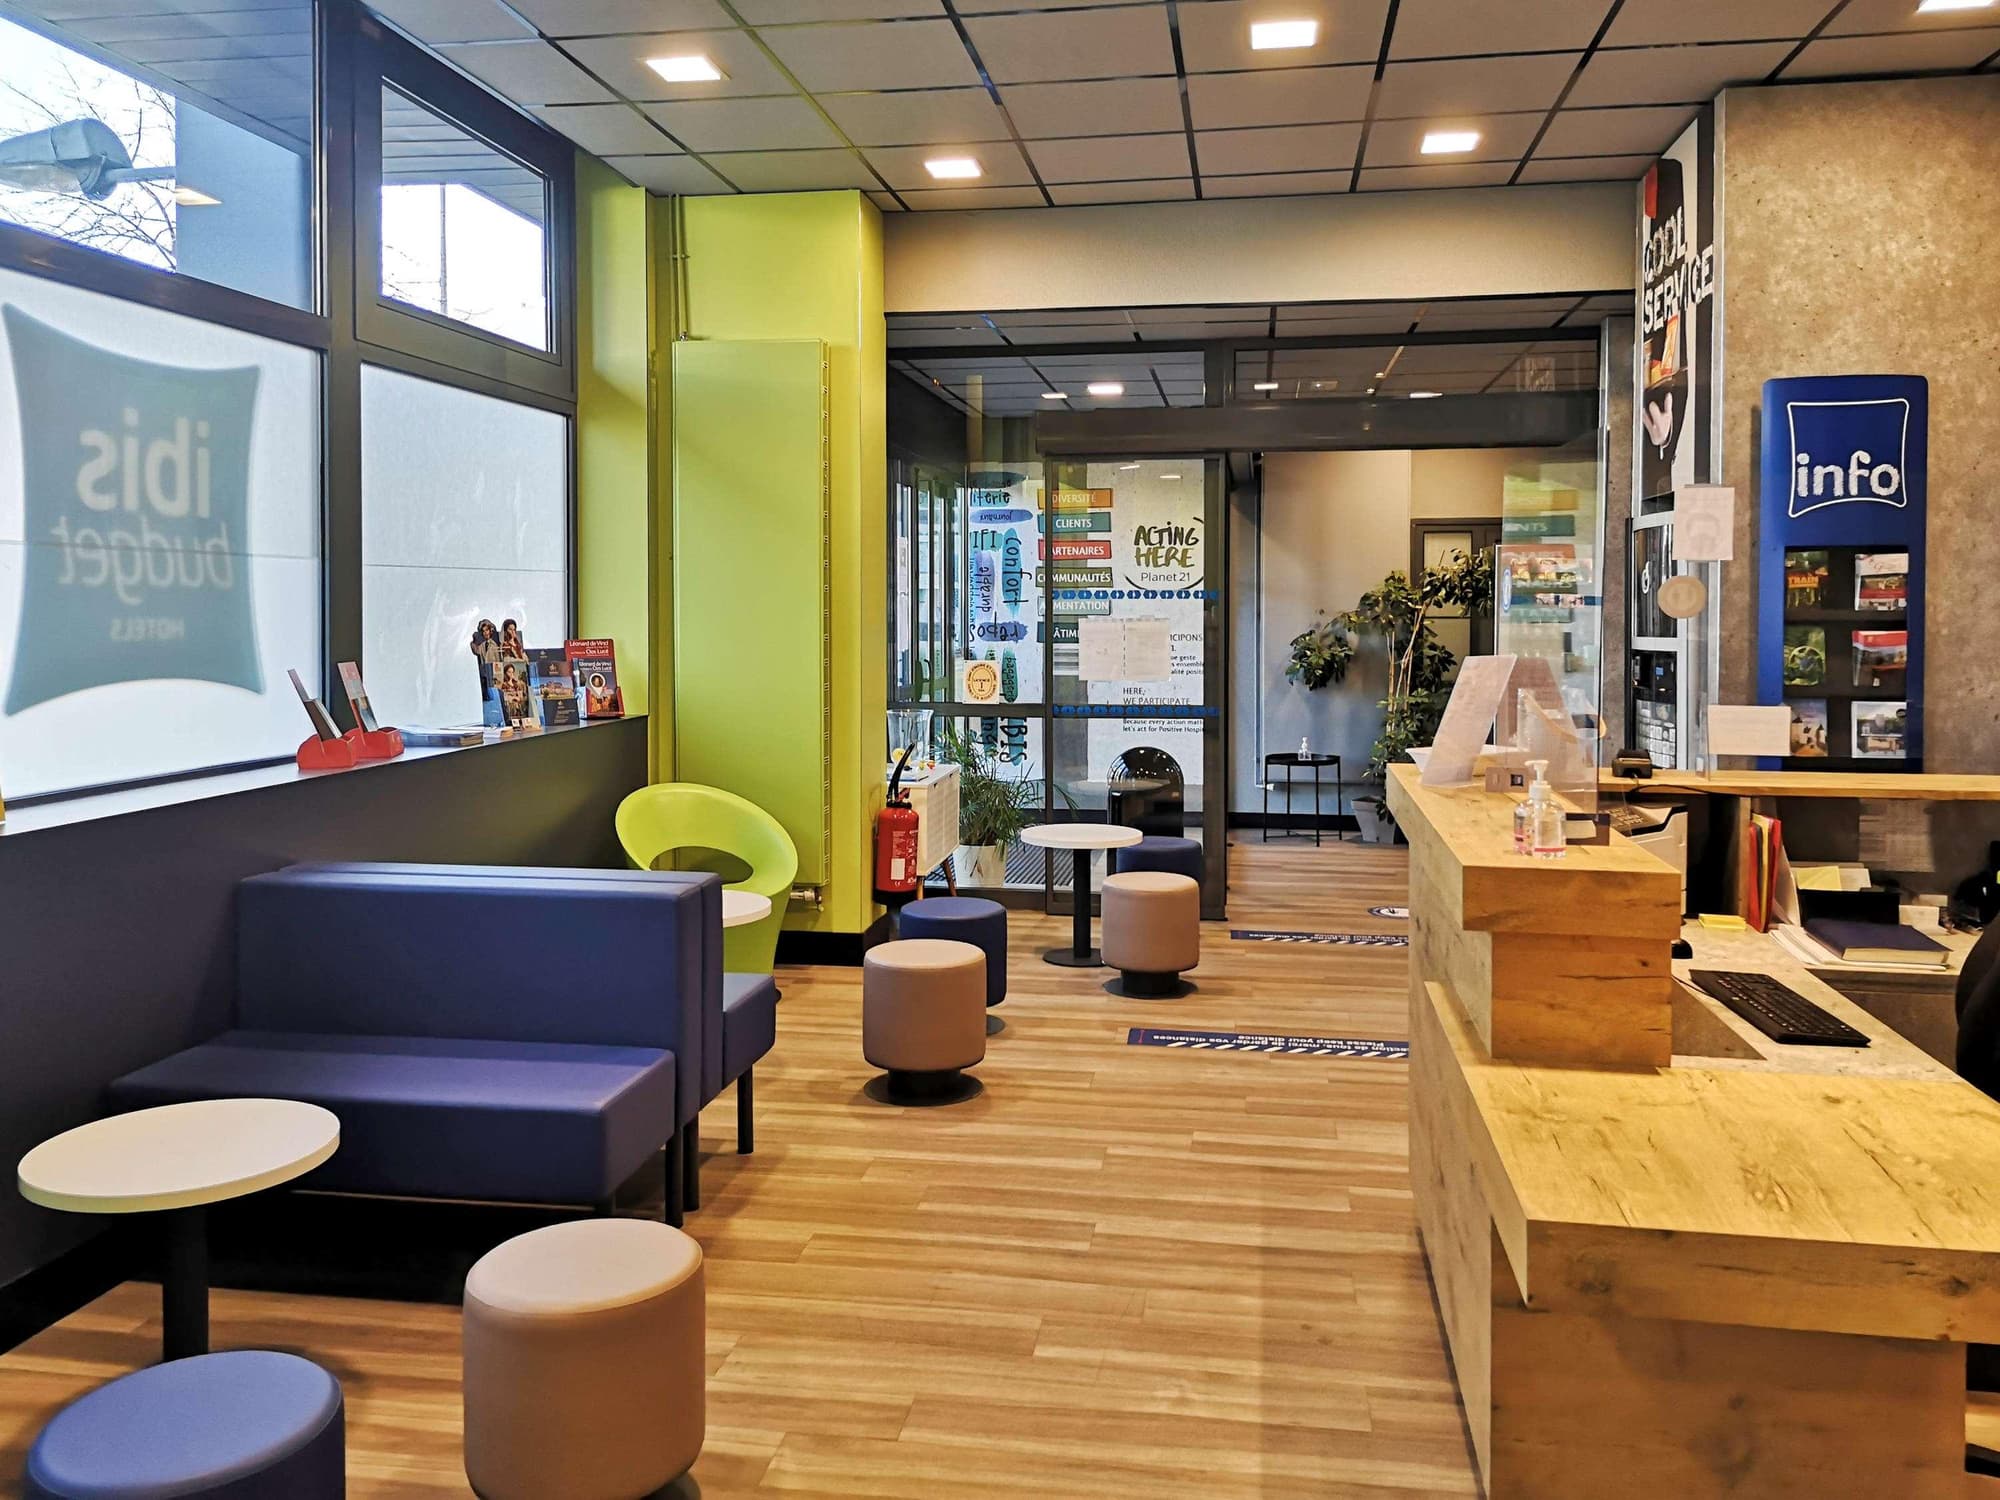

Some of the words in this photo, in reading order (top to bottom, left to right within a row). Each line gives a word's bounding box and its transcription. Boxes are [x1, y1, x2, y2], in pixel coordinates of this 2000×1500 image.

[1644, 205, 1688, 285] COOL
[1643, 243, 1714, 335] SERVICE
[1796, 449, 1901, 498] info
[1052, 493, 1097, 503] DIVERSITÉ
[1055, 518, 1093, 529] CLIENTS
[1133, 520, 1200, 547] ACTING
[970, 528, 998, 551] IFI
[1048, 545, 1105, 556] ARTENAIRES
[1134, 546, 1196, 568] HERE
[1037, 571, 1112, 583] CMMUNAUTÉS
[1141, 572, 1179, 582] Planet
[1180, 572, 1191, 582] 21
[1040, 600, 1110, 611] AMENTATION
[1138, 697, 1191, 705] PARTICIPATE
[1153, 1035, 1206, 1043] distances
